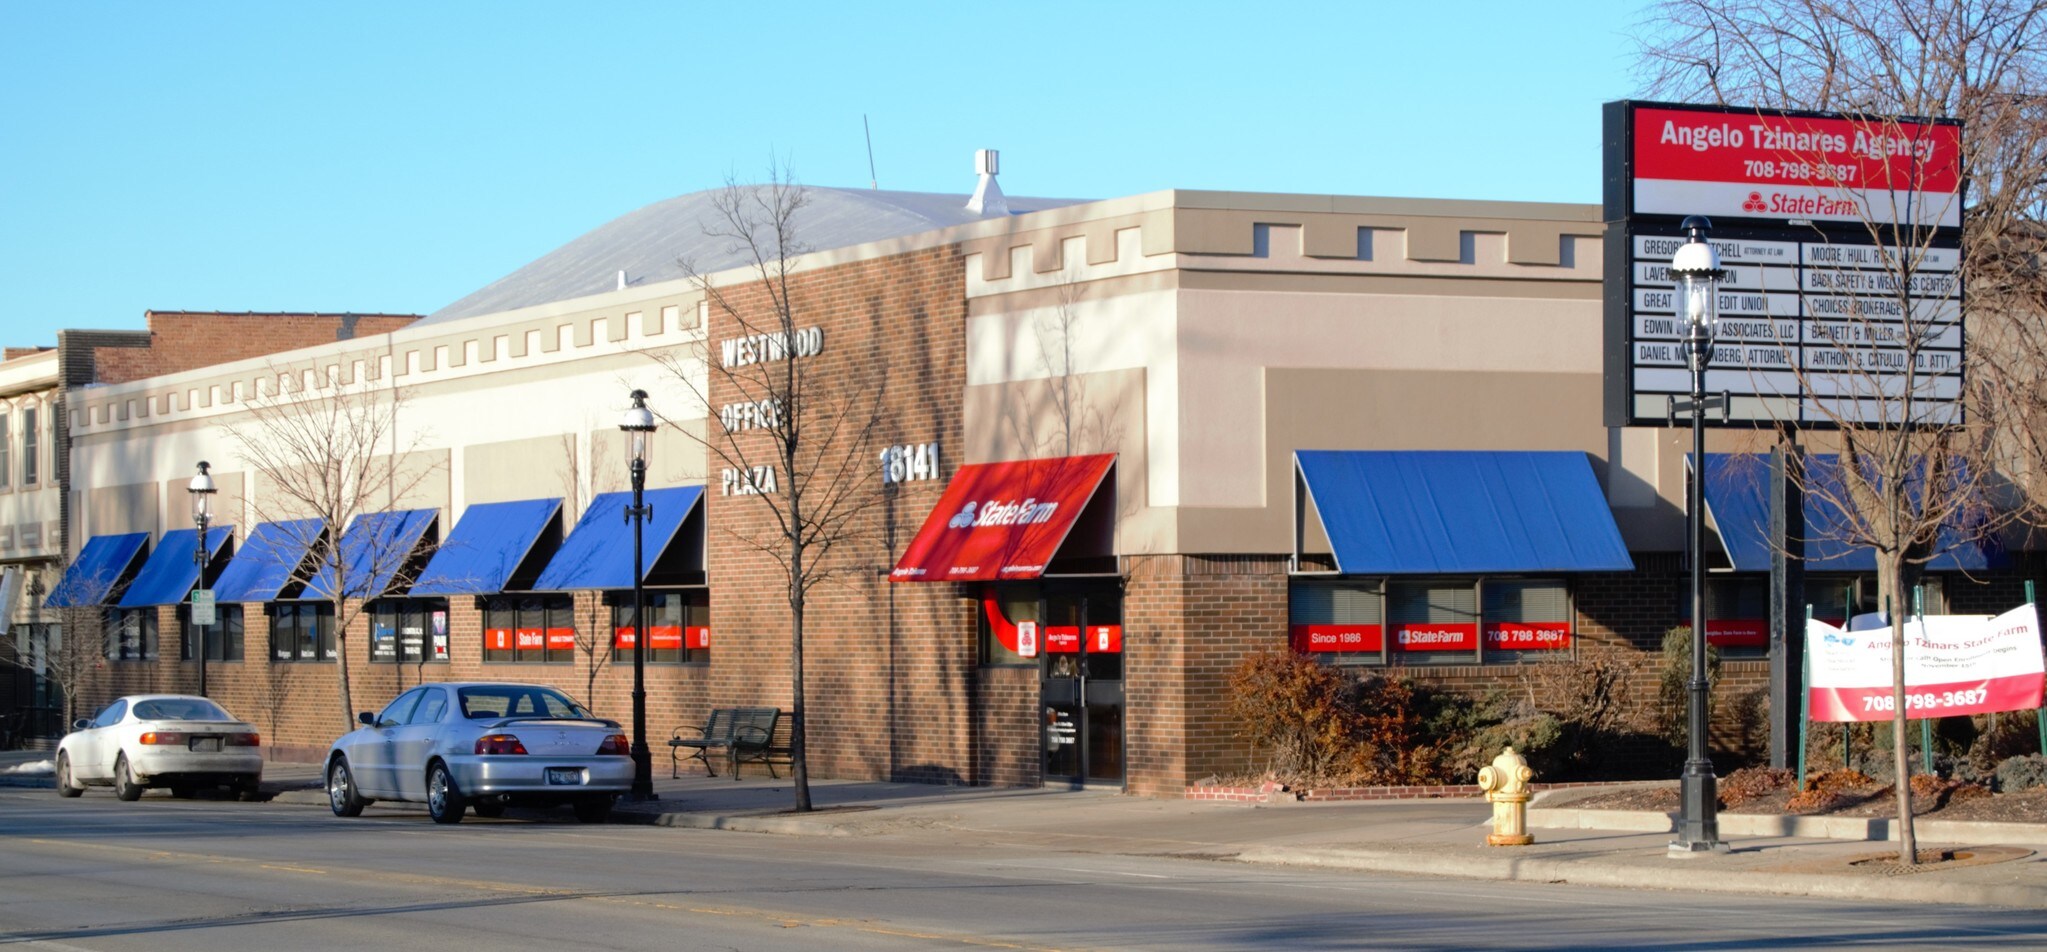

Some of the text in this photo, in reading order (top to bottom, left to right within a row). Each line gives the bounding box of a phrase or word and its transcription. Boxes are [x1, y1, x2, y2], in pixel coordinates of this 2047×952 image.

[1661, 119, 1936, 163] Angelo Tzinares Agency
[1744, 159, 1858, 182] 708-798-3687
[1707, 242, 1742, 258] TCHELL
[1744, 247, 1766, 256] ATTORNEY
[1767, 248, 1774, 256] AT
[1774, 248, 1784, 256] LAW
[1644, 266, 1672, 281] LAVER
[1811, 273, 1952, 292] BACK SAFETY & WELLNSS CENTER
[1644, 293, 1769, 312] GREAT EDIT UNION
[1812, 299, 1902, 316] CHOICES BROKERAGE
[1644, 319, 1673, 335] EDWIN
[1721, 322, 1777, 340] ASSOCIATES,
[1779, 324, 1794, 339] LLC
[1811, 324, 1850, 341] BARNETT
[1854, 326, 1860, 337] &
[1863, 326, 1895, 341] MILLER
[721, 326, 824, 368] WESTWOOD
[1640, 345, 1672, 361] DANIEL
[1712, 348, 1745, 366] NBERG,
[1748, 349, 1793, 365] ATTORNEY
[1812, 350, 1853, 366] ANTHONY
[1914, 354, 1927, 368] TD.
[721, 399, 785, 433] OFFICE
[879, 442, 941, 483] 18141
[721, 465, 779, 497] PLAZA
[1311, 632, 1362, 643] Since 1986
[1487, 629, 1565, 642] 708 798 3687
[1867, 641, 1910, 650] Ango
[1963, 635, 1995, 650] State
[1997, 625, 2028, 638] Farm
[1862, 688, 1988, 712] 708798-3687
